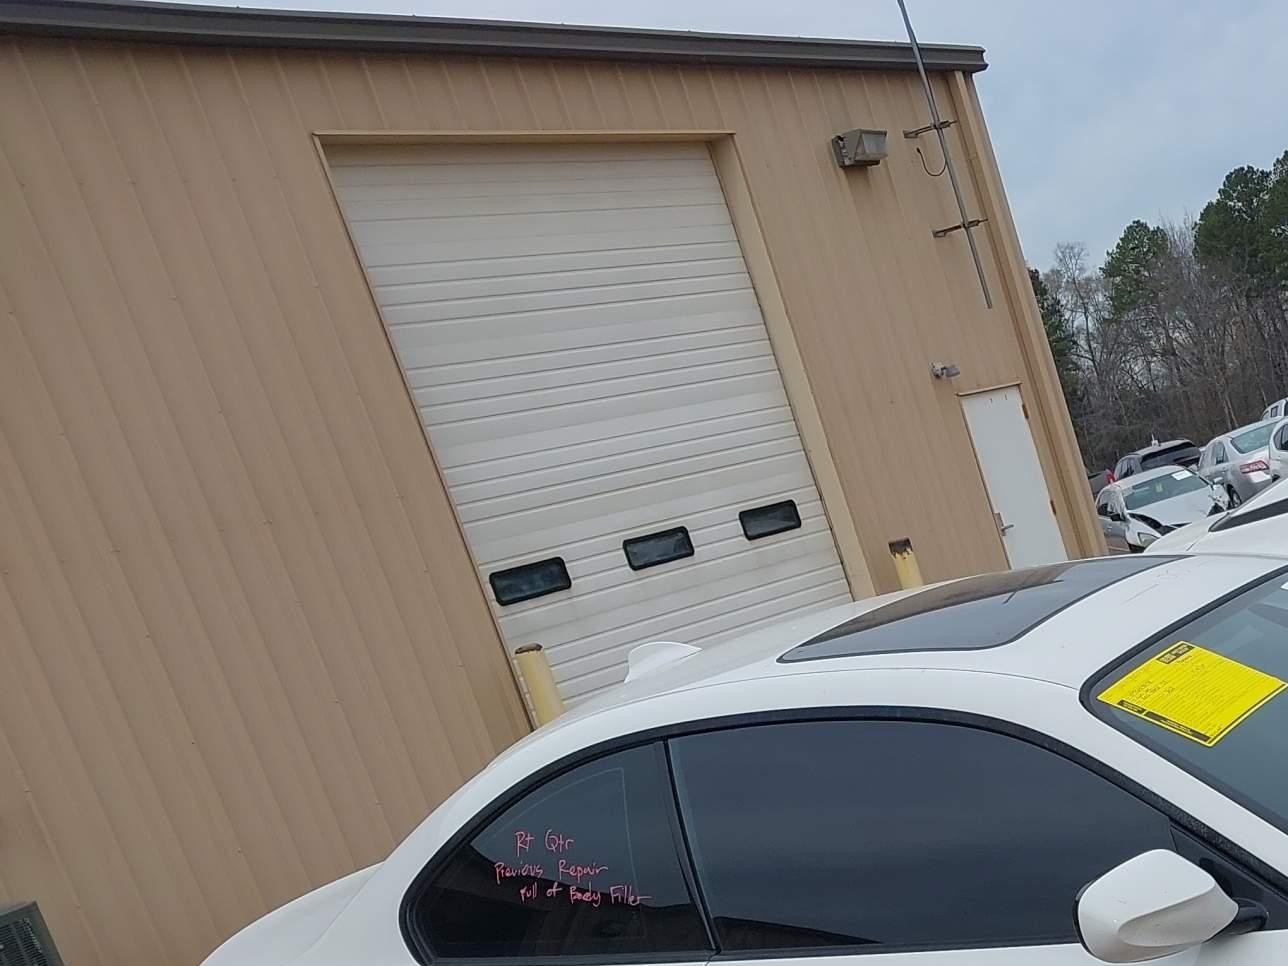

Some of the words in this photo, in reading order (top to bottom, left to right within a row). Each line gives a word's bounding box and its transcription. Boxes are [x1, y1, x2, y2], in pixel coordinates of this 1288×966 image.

[515, 831, 535, 856] Rt
[545, 829, 574, 852] Qtr
[494, 861, 544, 884] Previous
[559, 860, 608, 882] Repair
[547, 882, 562, 897] of
[570, 882, 601, 907] Body
[610, 885, 651, 906] Filler
